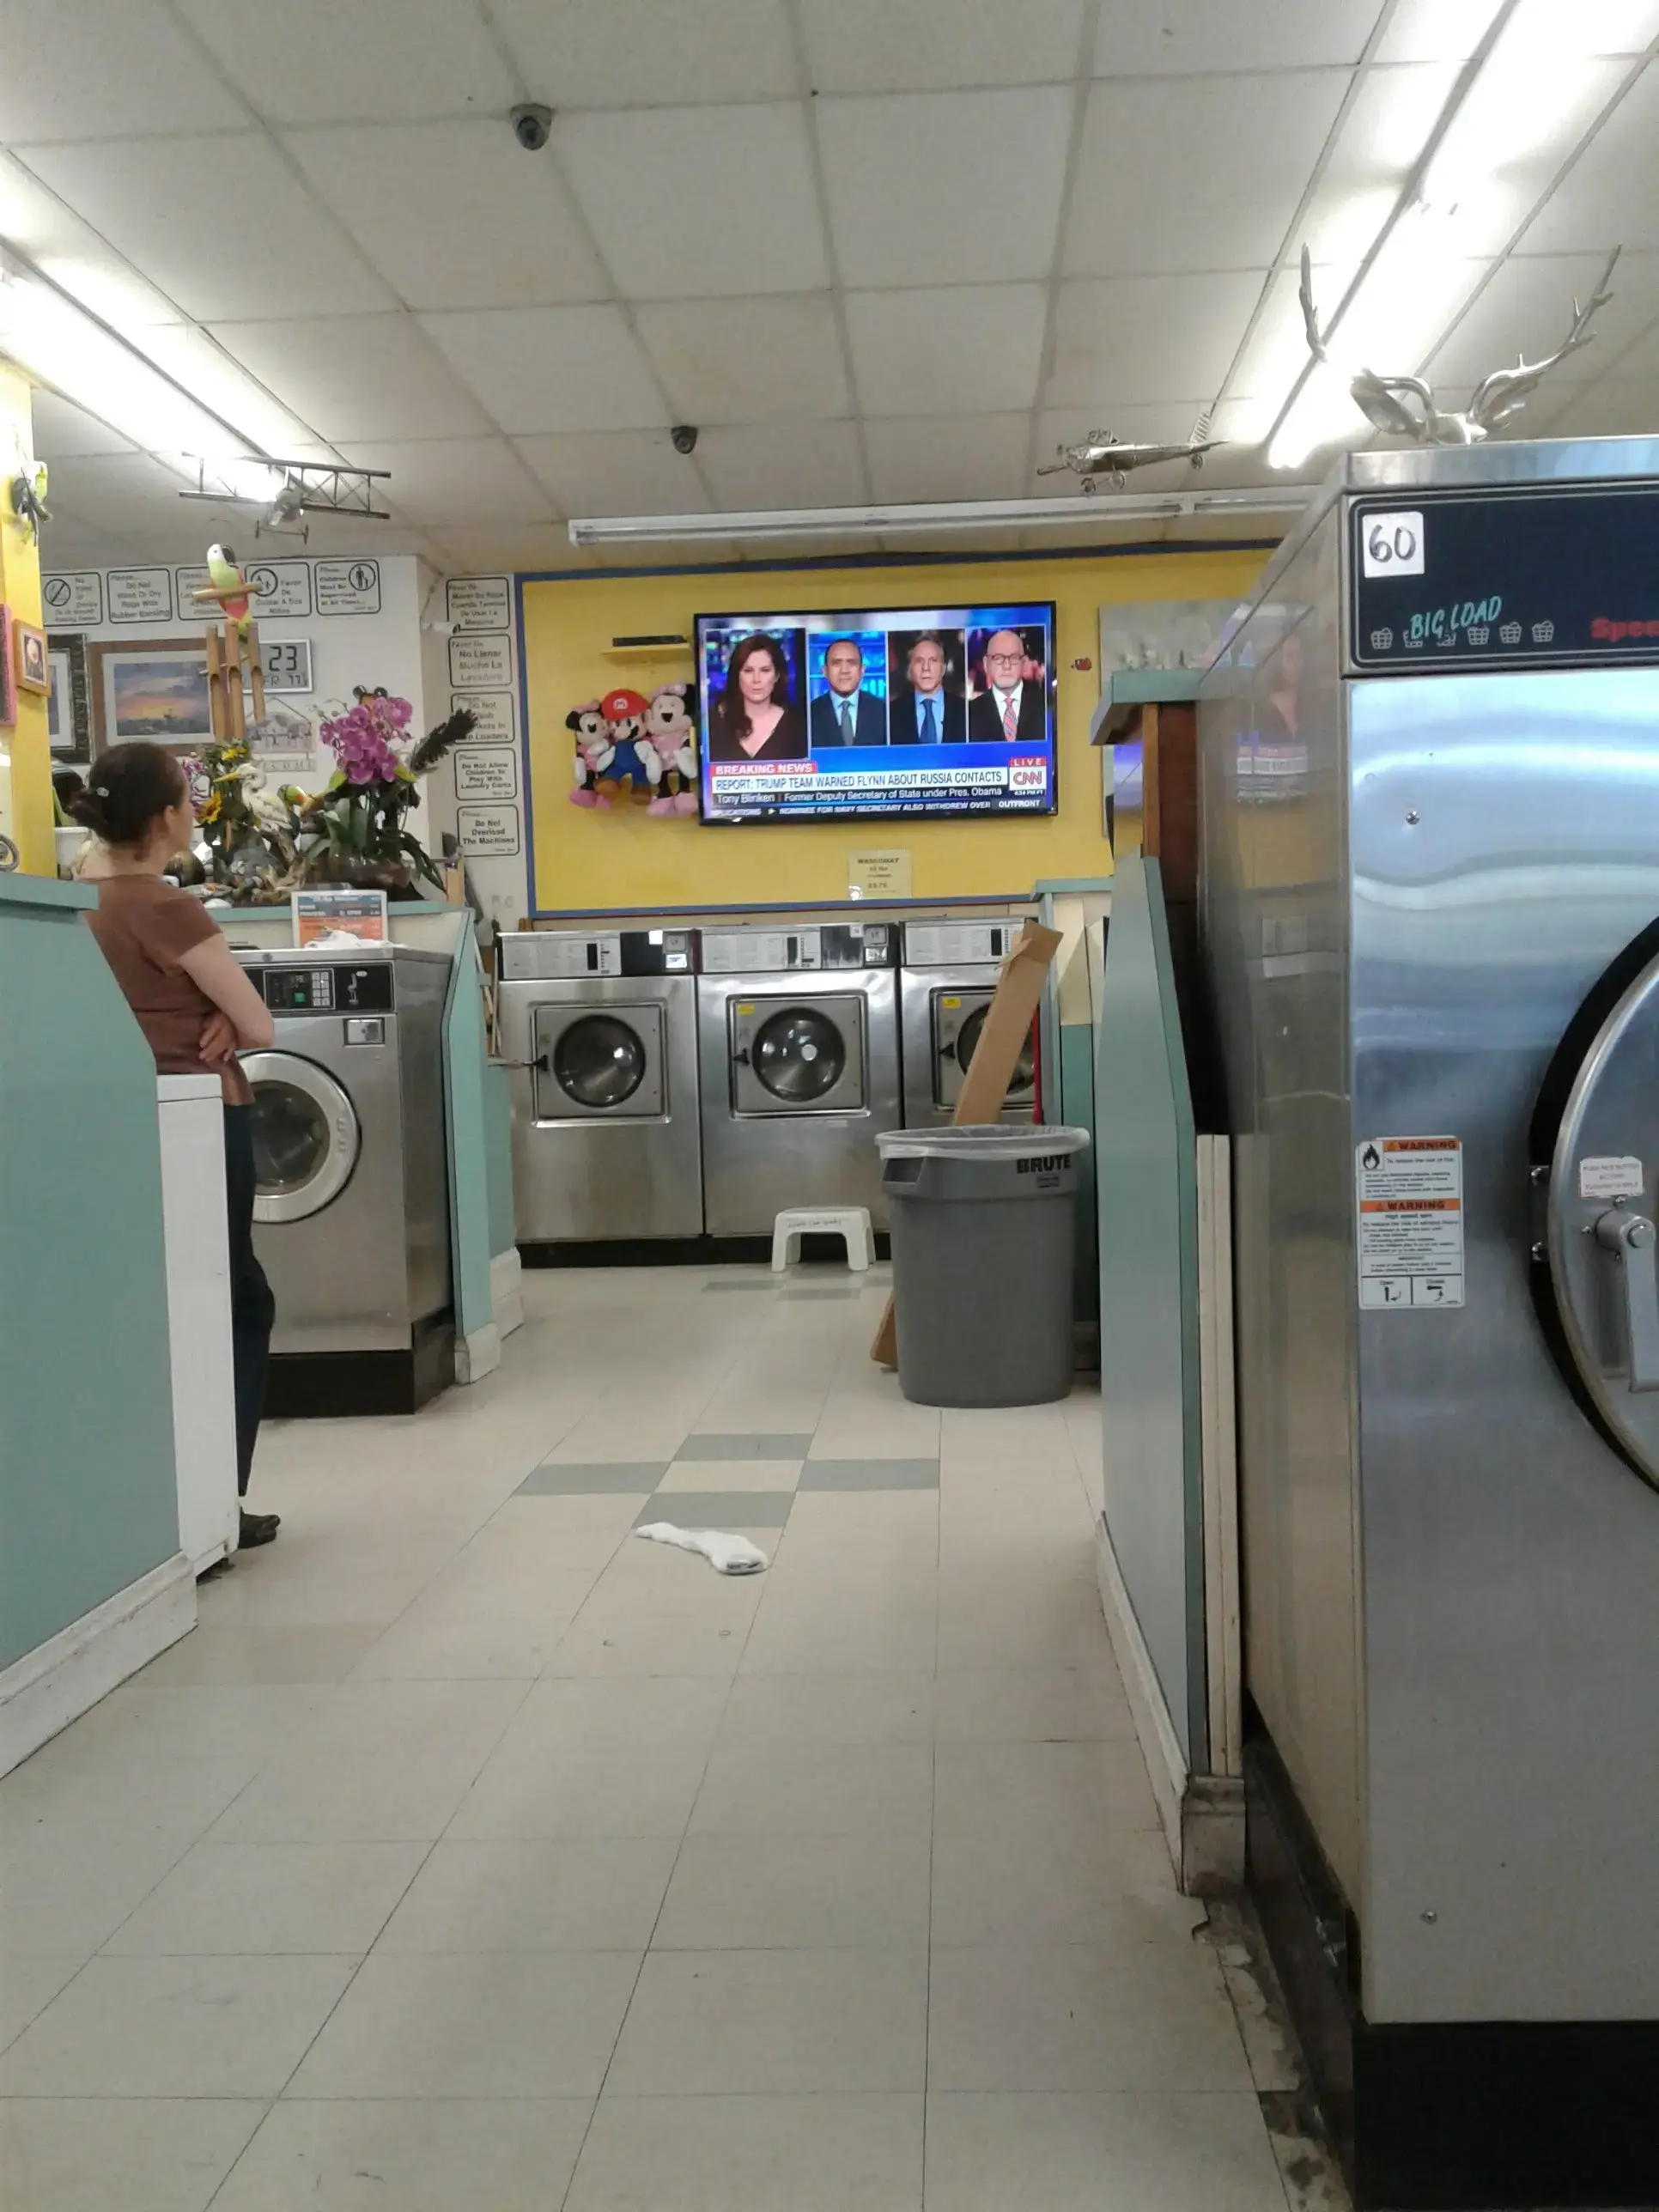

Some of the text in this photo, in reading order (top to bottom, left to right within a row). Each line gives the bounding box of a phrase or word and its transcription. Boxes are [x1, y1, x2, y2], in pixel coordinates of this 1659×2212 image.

[1369, 525, 1416, 563] 60
[1410, 595, 1503, 640] BIG LOAD
[269, 646, 297, 672] 23
[715, 763, 813, 775] BREAKING NEWS
[1014, 758, 1042, 767] LIVE
[716, 771, 1002, 791] REPORT: TRUMP TEAM WARNED FLYNN ABOUT RUSSIA CONTACTS
[1013, 771, 1042, 786] CNN
[717, 787, 1002, 805] Tony Blinken Former Deputy Secretary of State under Pres. Obama
[1398, 1139, 1457, 1151] WARNING
[1017, 1153, 1073, 1174] BRUTE
[1388, 1200, 1445, 1210] WARNING
